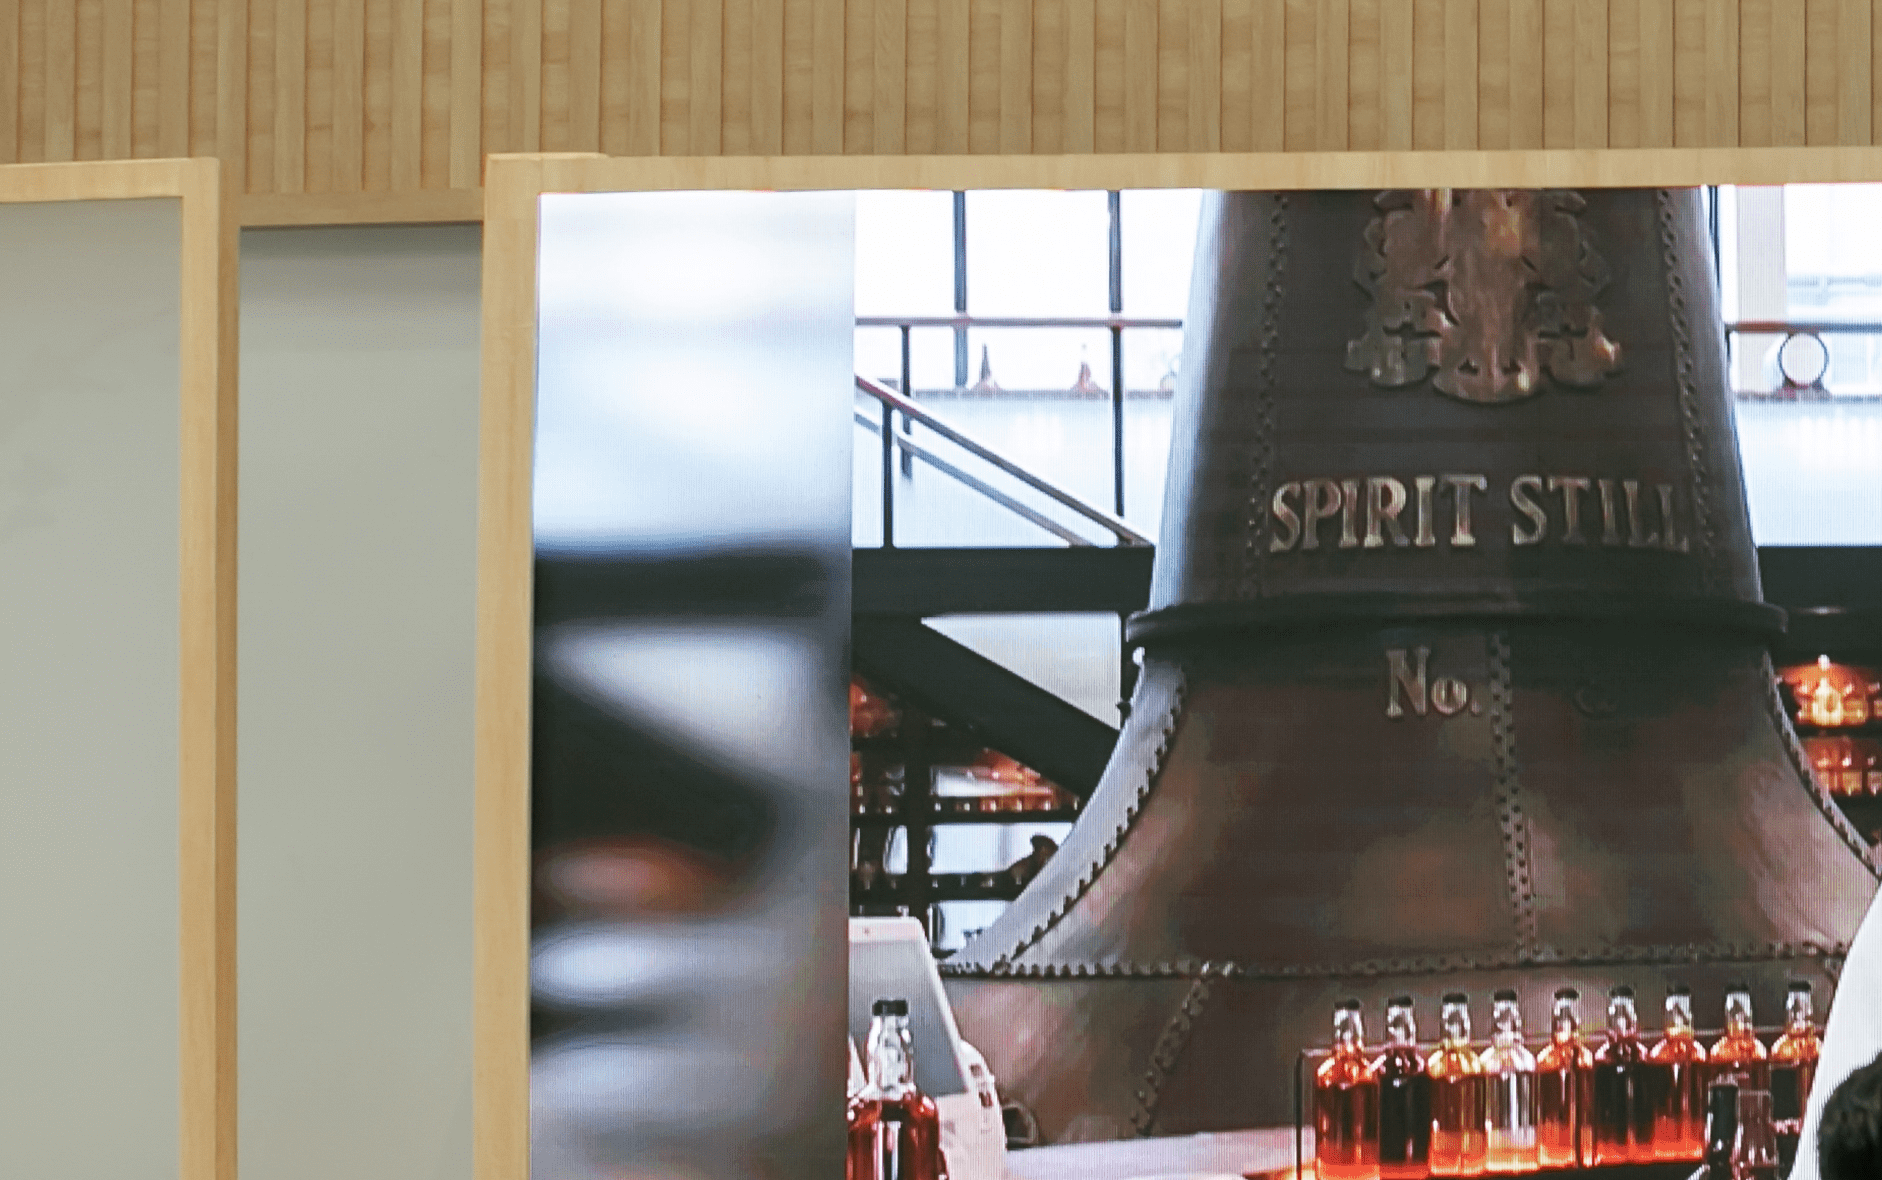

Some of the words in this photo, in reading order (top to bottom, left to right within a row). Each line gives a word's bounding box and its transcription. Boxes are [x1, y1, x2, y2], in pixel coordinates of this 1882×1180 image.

[1269, 473, 1488, 553] SPIRIT
[1510, 473, 1690, 554] STILL
[1385, 645, 1482, 718] No.
